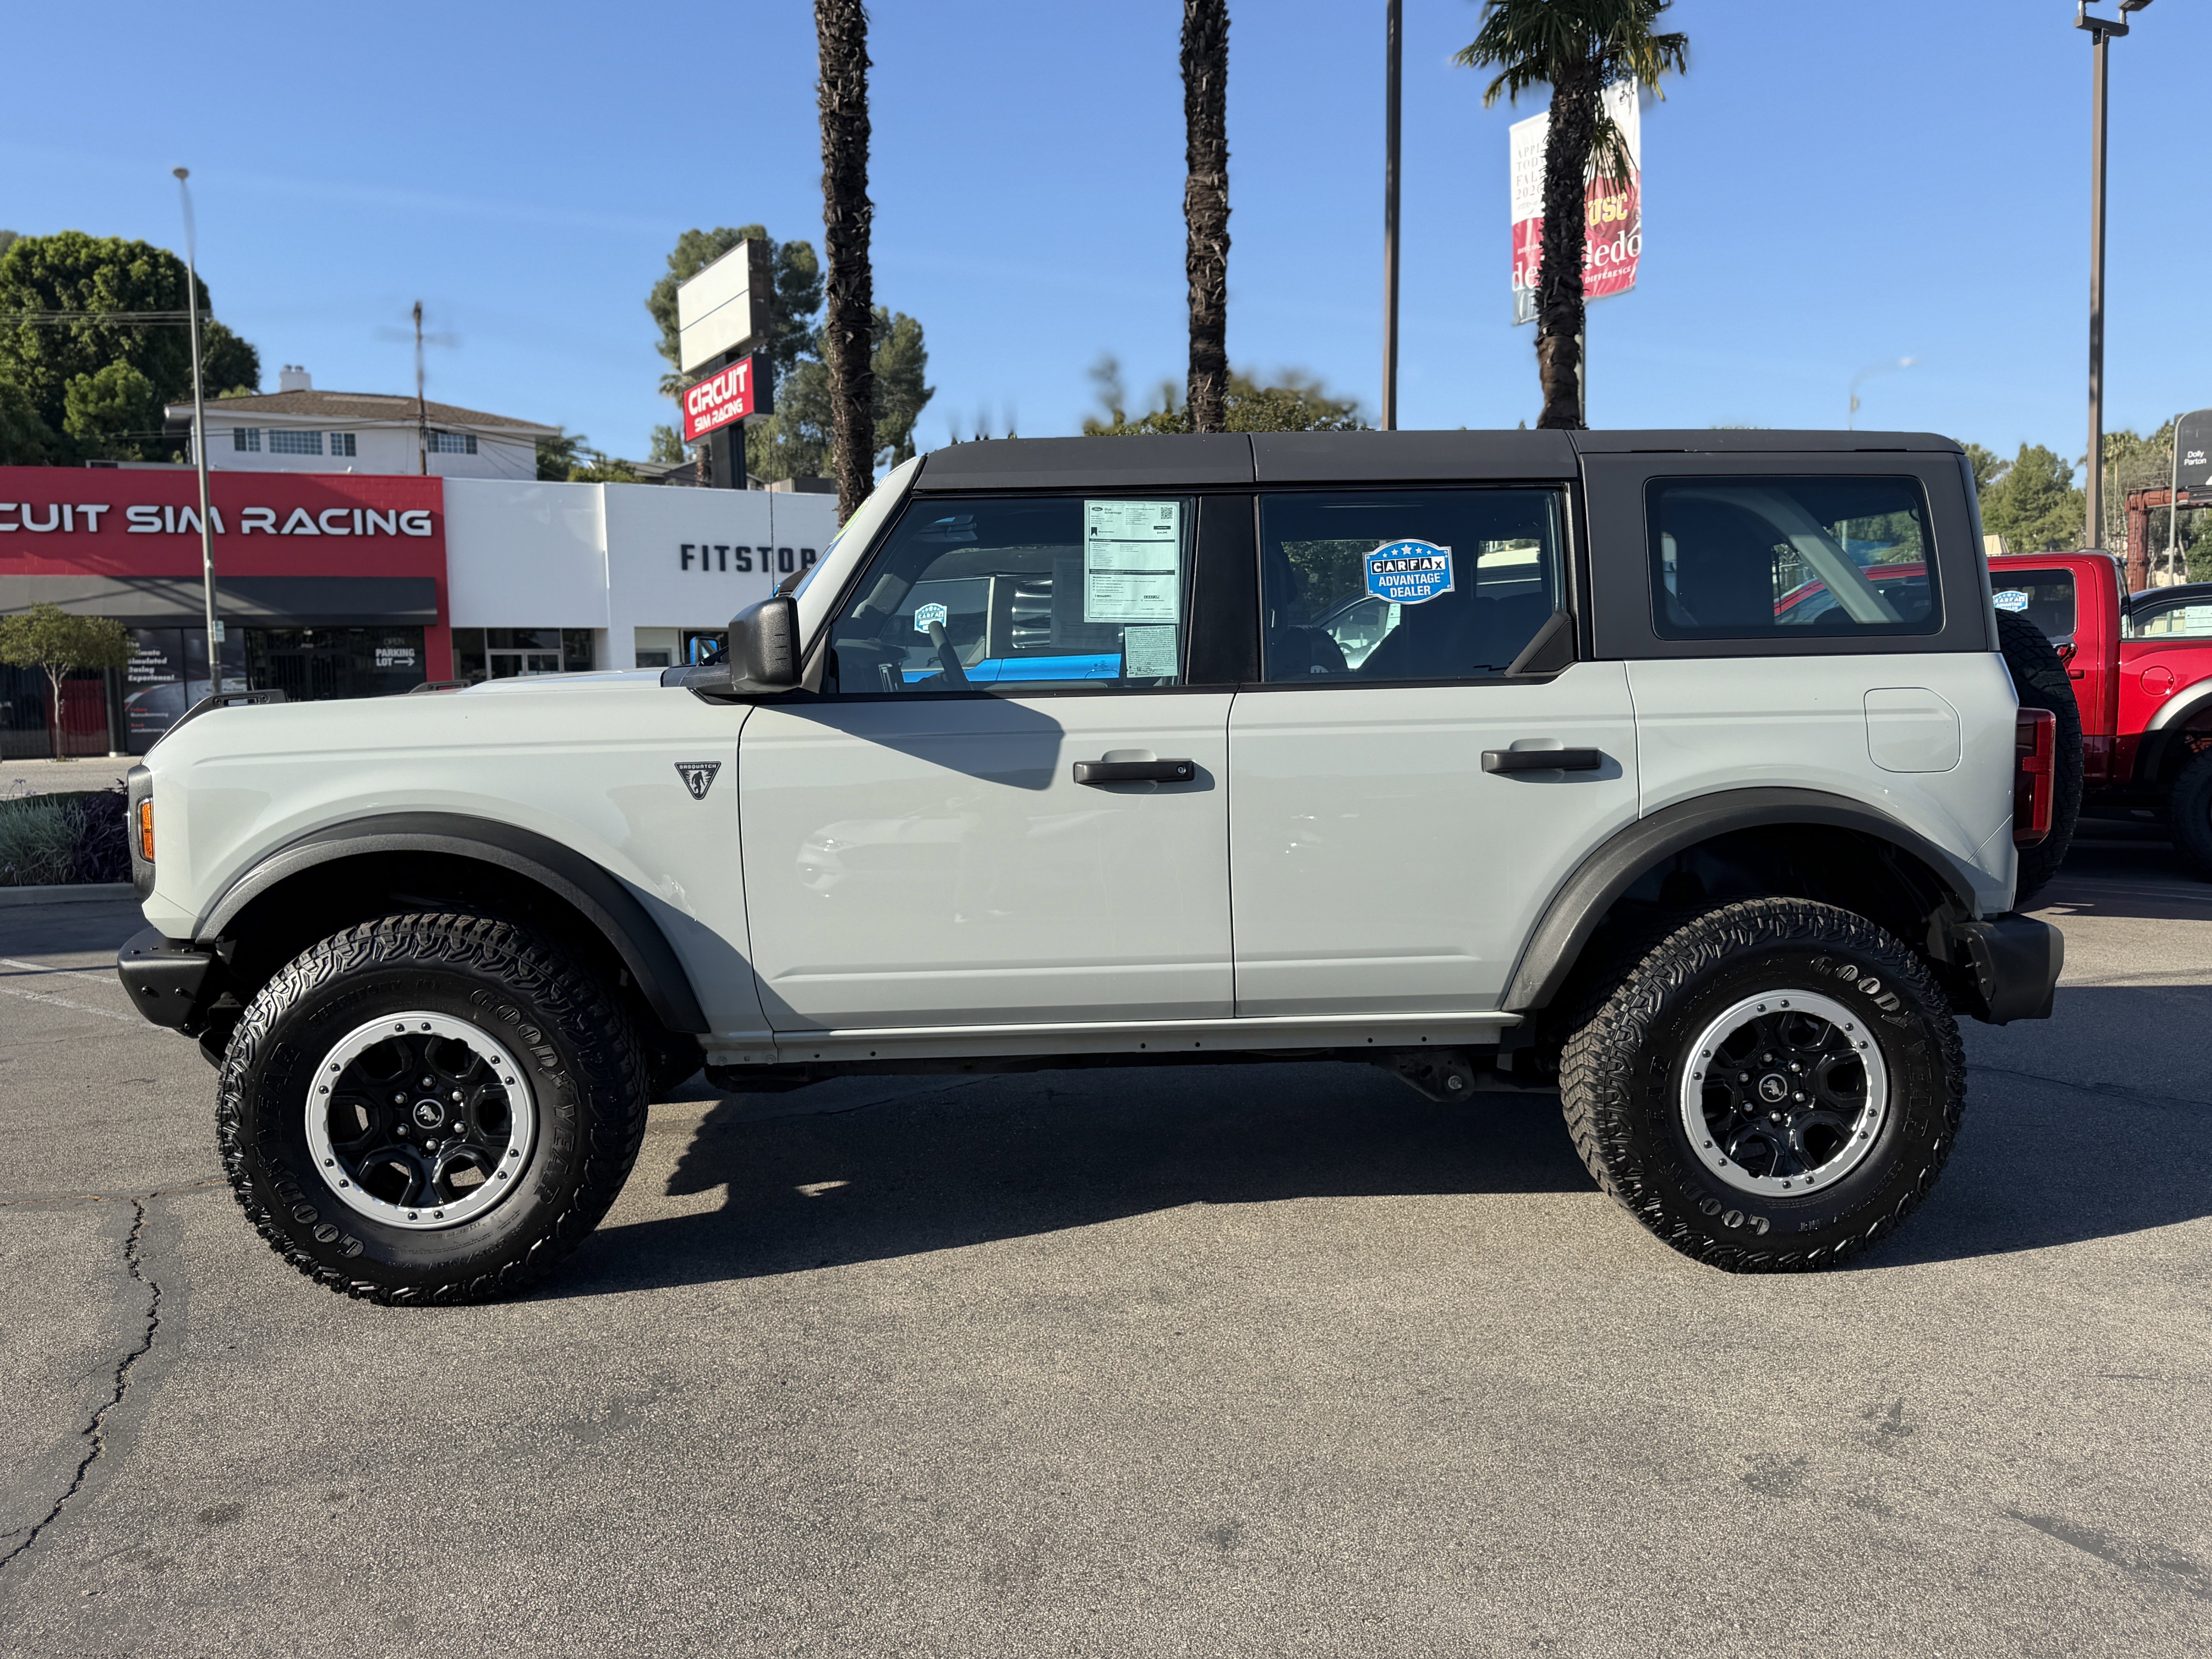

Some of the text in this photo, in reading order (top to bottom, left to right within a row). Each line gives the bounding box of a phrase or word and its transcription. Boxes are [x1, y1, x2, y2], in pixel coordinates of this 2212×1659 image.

[1518, 143, 1540, 158] APPL
[1516, 156, 1544, 172] TODA
[1588, 192, 1628, 227] USC
[1585, 220, 1642, 270] ledó
[688, 364, 748, 416] CIRCUIT
[694, 398, 743, 433] SIM RACING
[125, 505, 225, 534] SIM
[241, 506, 432, 536] RACING
[681, 544, 817, 573] FITSTOP
[1373, 558, 1442, 572] CARFAX
[1379, 573, 1441, 587] ADVANTAGE
[1390, 585, 1431, 598] DEALER
[376, 648, 415, 658] PARKING
[376, 658, 393, 667] LOT
[128, 674, 174, 683] Experience!
